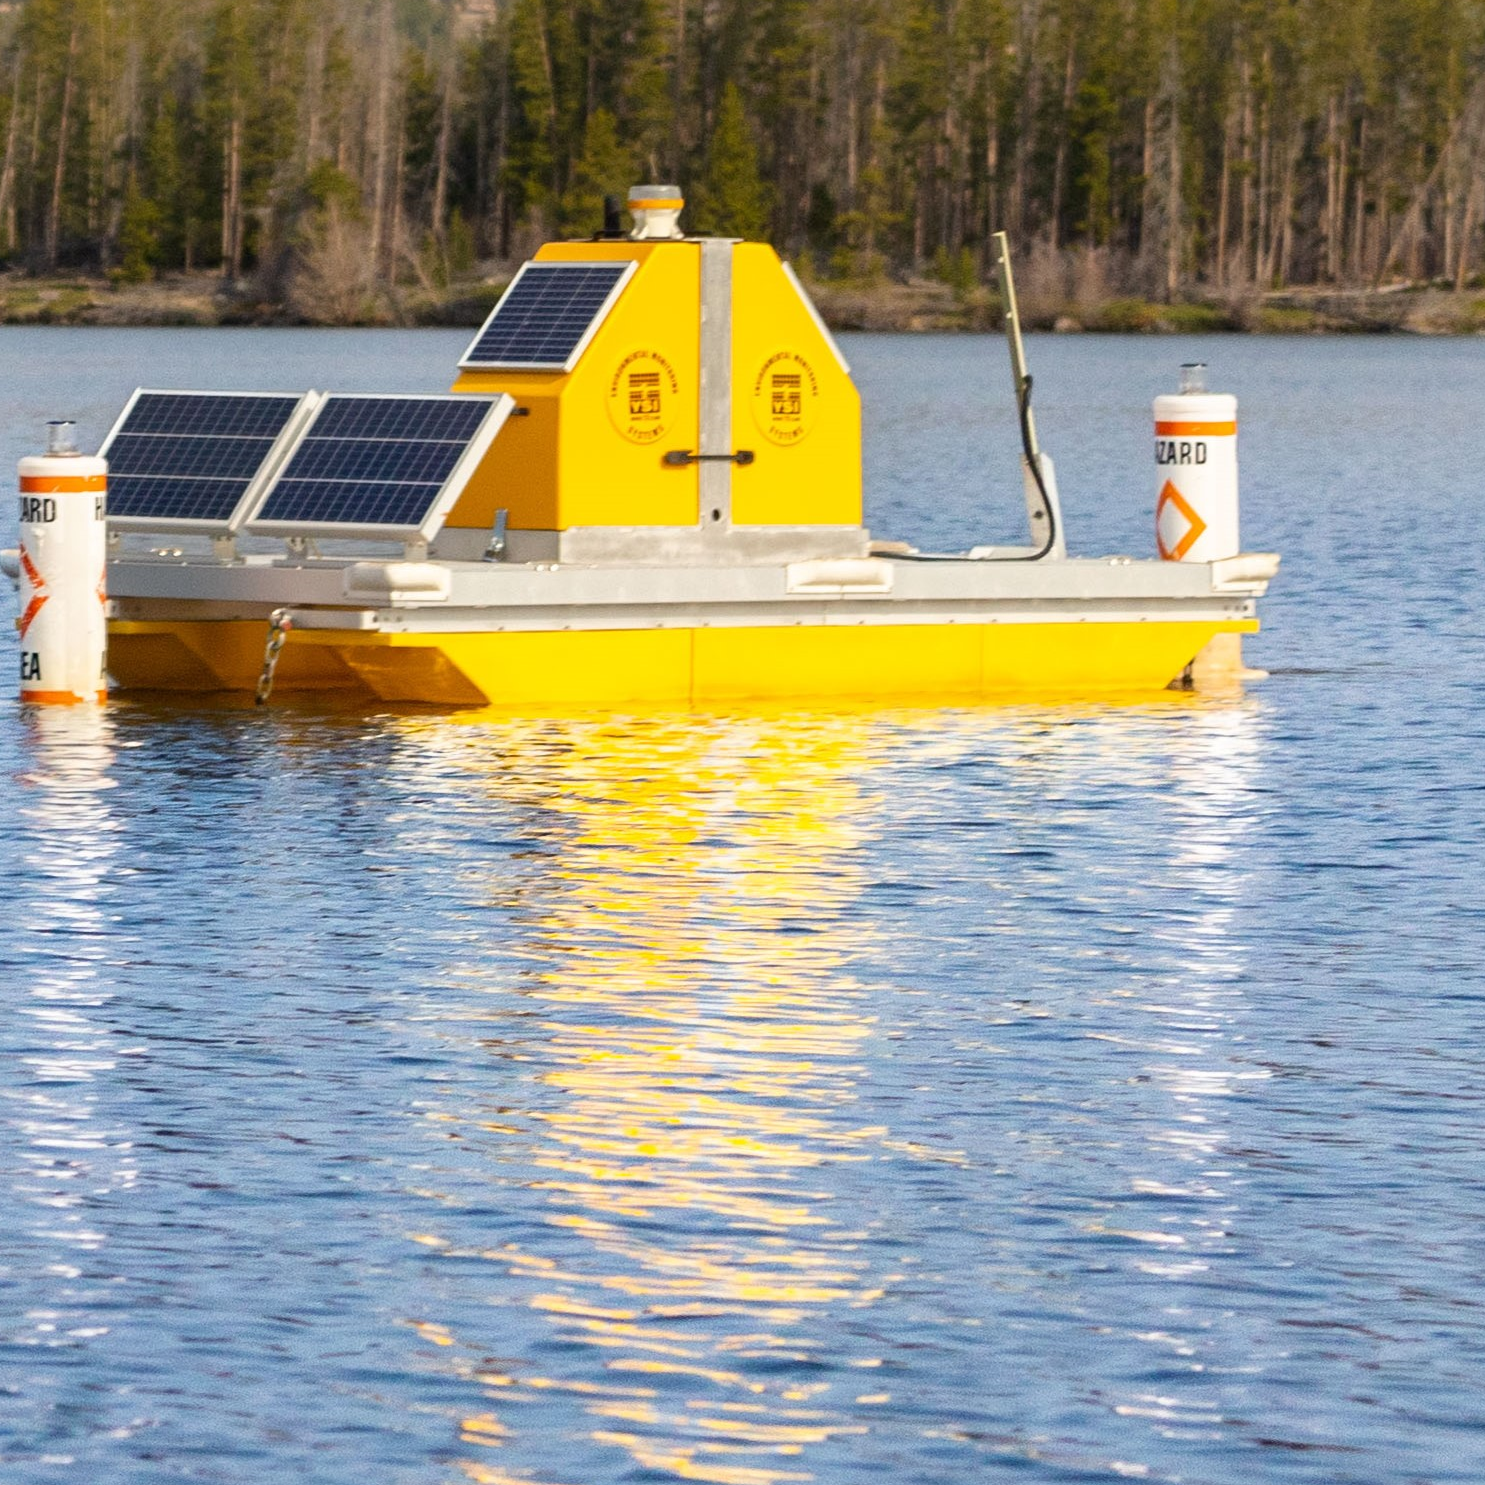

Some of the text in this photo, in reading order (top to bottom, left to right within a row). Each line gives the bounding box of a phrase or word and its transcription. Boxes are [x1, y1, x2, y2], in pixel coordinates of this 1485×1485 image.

[630, 400, 659, 413] YSI
[773, 401, 800, 413] YSI
[1155, 440, 1207, 465] ZARD
[19, 497, 57, 523] ARD
